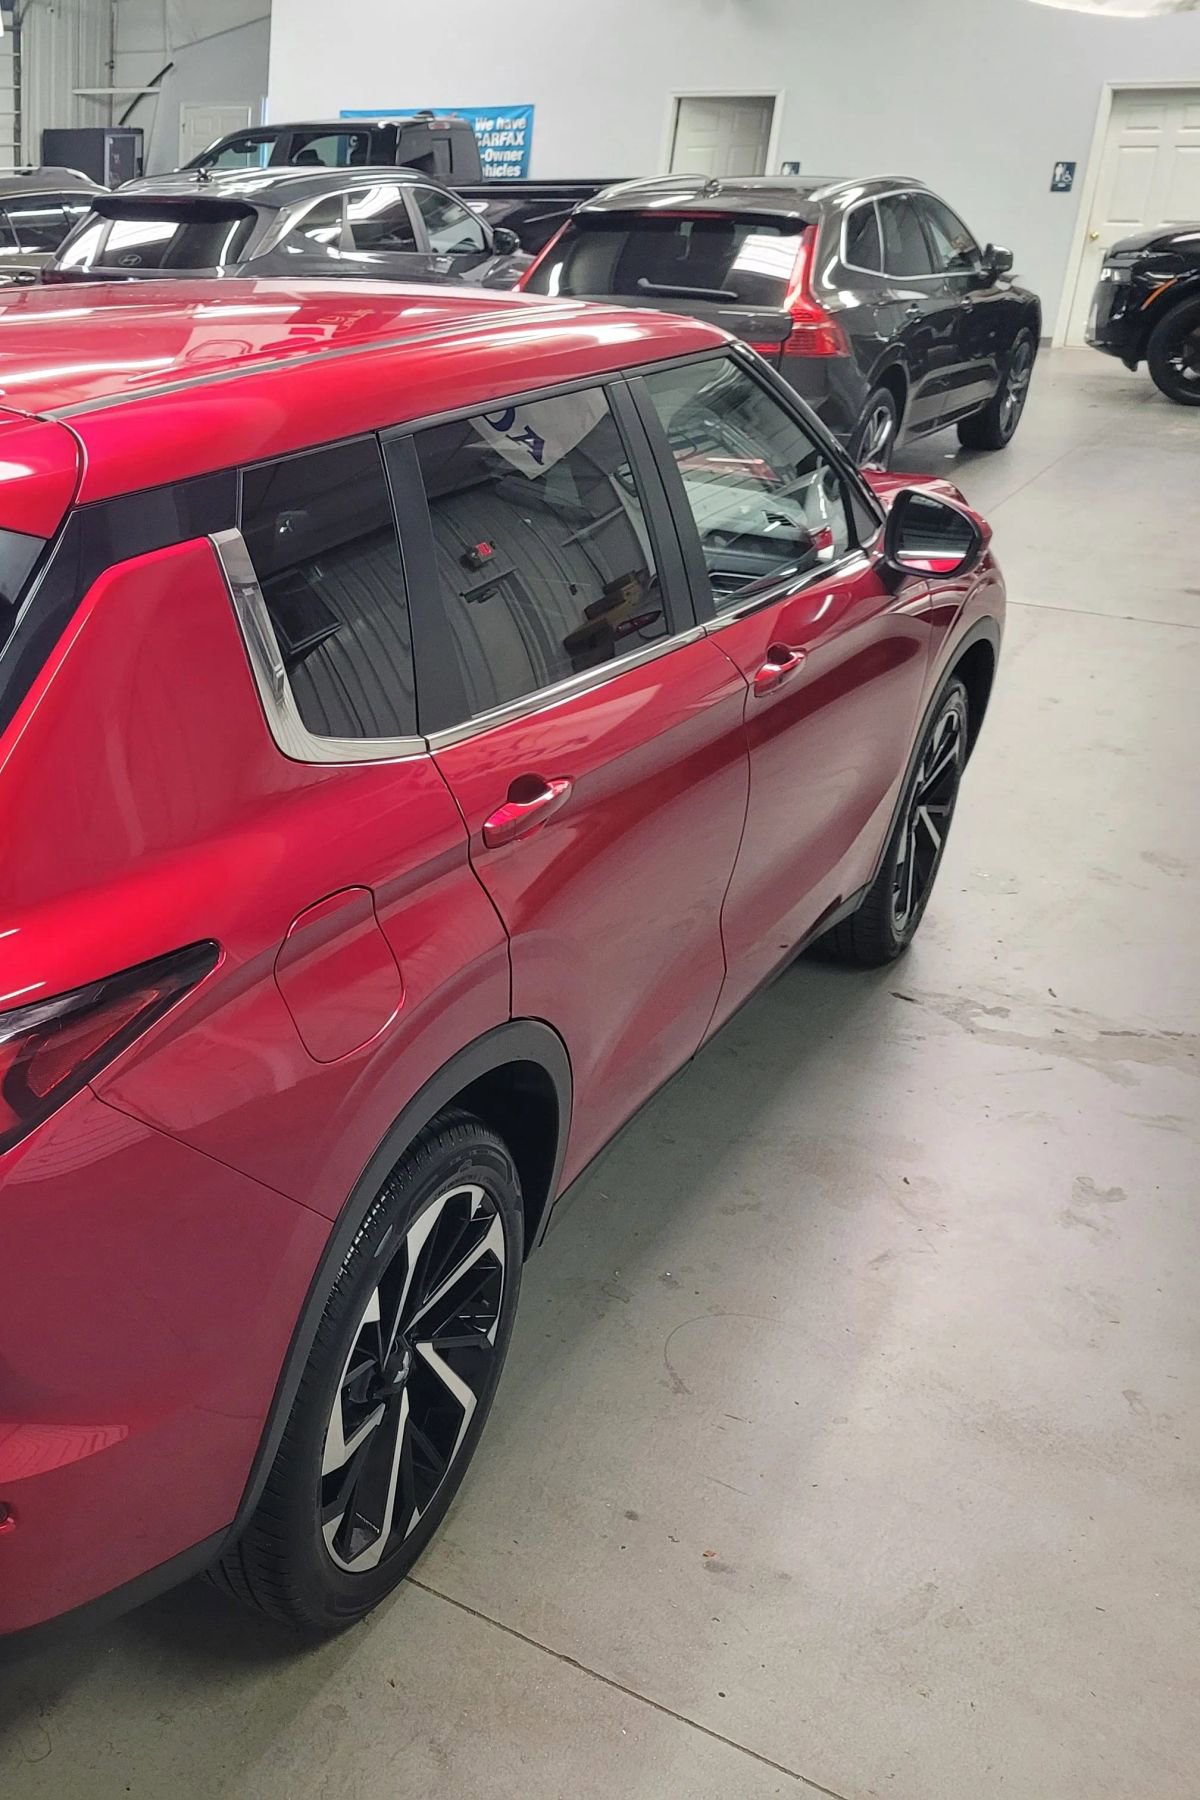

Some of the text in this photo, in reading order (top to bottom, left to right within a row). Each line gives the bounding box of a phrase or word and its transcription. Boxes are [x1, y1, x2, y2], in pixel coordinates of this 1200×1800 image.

[475, 117, 527, 131] We have
[475, 131, 525, 147] CARFAX
[480, 148, 524, 162] -Owner
[482, 163, 521, 178] hicles
